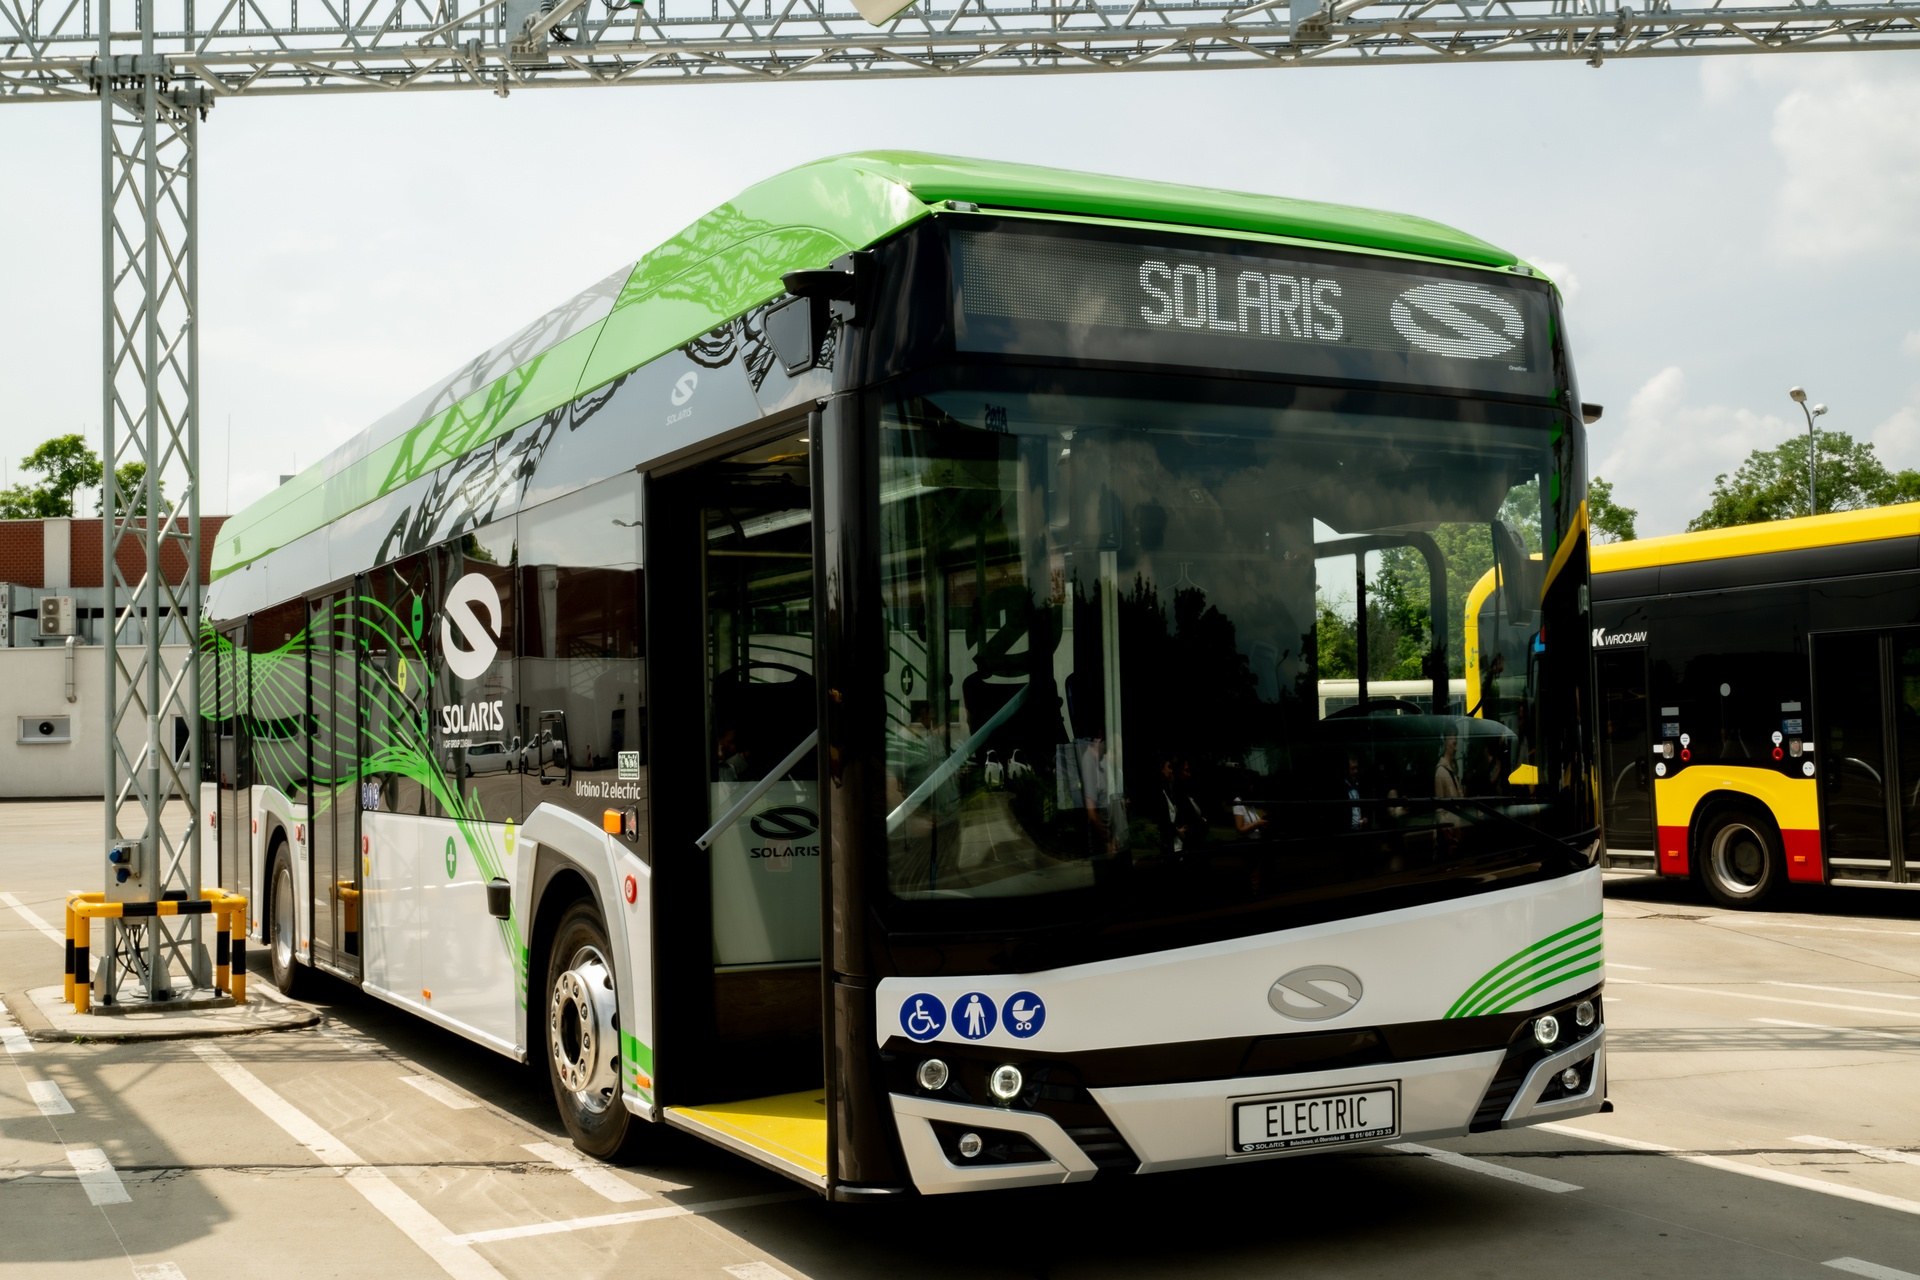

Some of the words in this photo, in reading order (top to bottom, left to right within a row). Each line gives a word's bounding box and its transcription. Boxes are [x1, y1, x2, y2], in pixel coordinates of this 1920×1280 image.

[1139, 260, 1343, 340] SOLARIS
[1592, 628, 1606, 647] K
[1605, 631, 1648, 645] WROCŁAW
[442, 700, 504, 735] SOLARIS
[576, 780, 600, 798] Urbino
[601, 781, 609, 798] 12
[610, 782, 641, 800] electric
[750, 846, 820, 859] SOLARIS
[1266, 1096, 1367, 1138] ELECTRIC
[1255, 1141, 1285, 1150] SOLARIS
